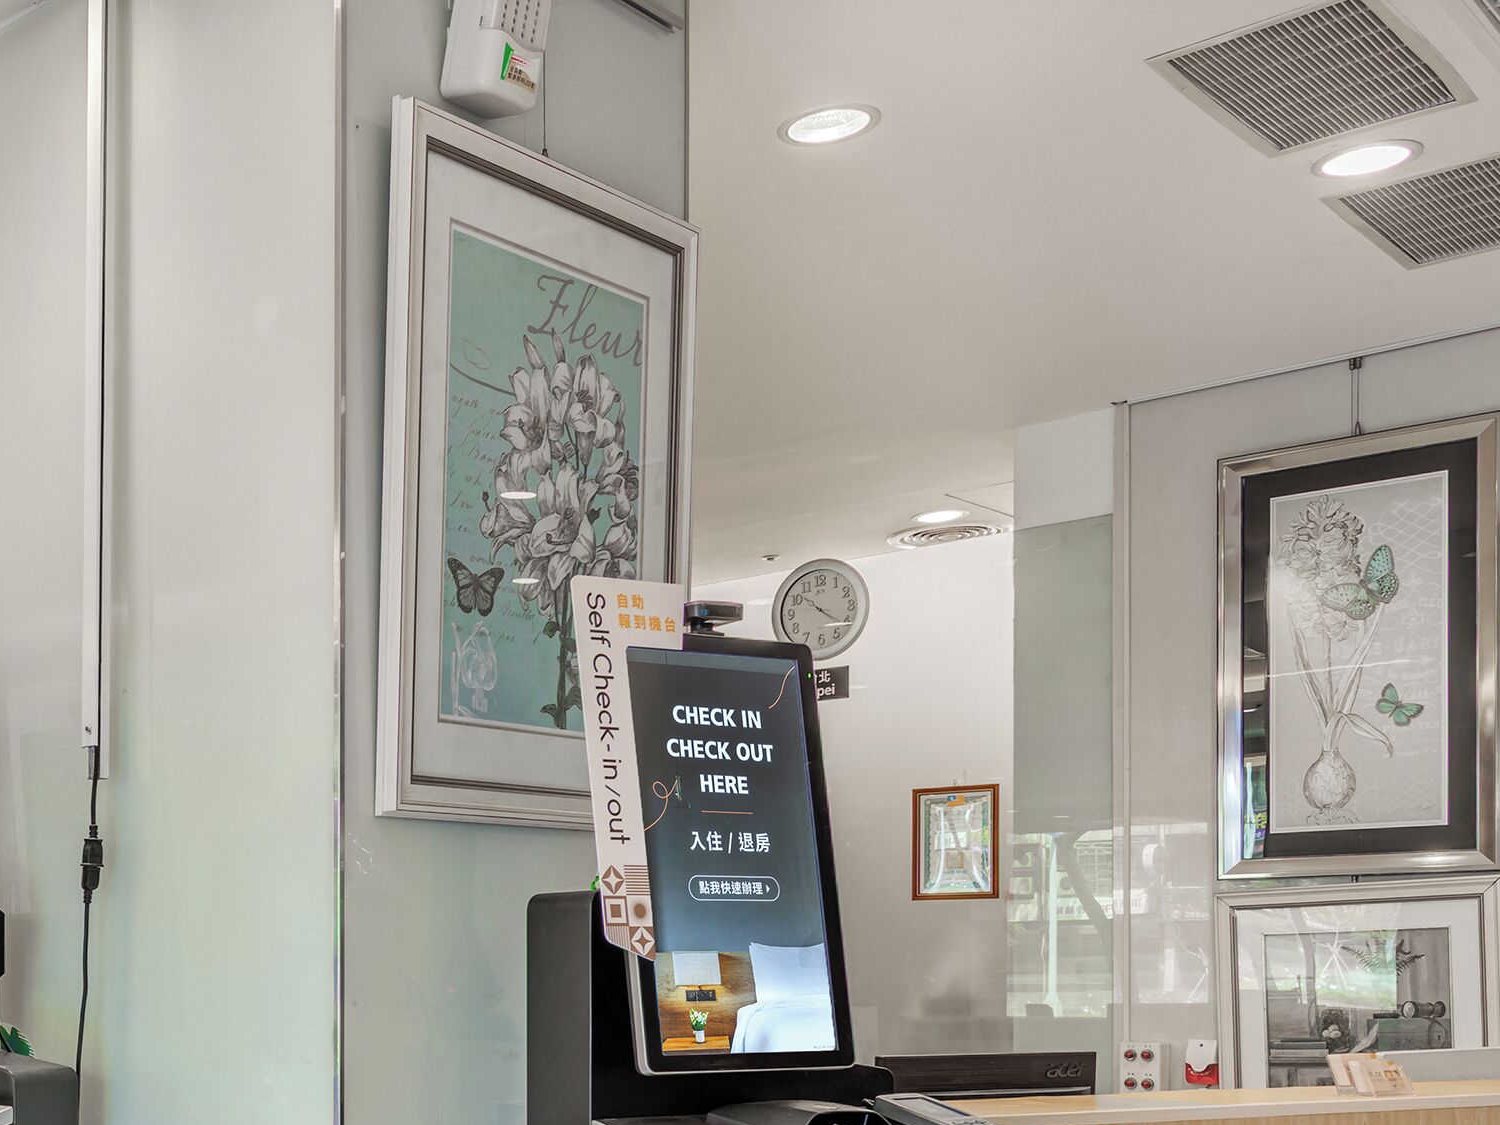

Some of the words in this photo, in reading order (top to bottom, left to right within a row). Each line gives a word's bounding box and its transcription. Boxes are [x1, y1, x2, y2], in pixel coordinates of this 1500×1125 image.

[527, 274, 643, 367] Fleur
[801, 581, 812, 593] 11
[814, 574, 826, 587] 12
[833, 576, 839, 588] 1
[842, 586, 851, 599] 2
[790, 593, 803, 606] 10
[847, 599, 855, 611] 3
[587, 592, 611, 648] Self
[787, 608, 795, 621] 9
[792, 622, 800, 634] 8
[833, 627, 840, 640] 5
[803, 632, 810, 643] 7
[819, 633, 826, 646] 6
[672, 705, 737, 728] CHECK
[742, 710, 762, 729] IN
[666, 738, 731, 760] CHECK
[736, 742, 773, 763] OUT
[700, 773, 749, 795] HERE
[690, 831, 723, 851] 入住
[738, 832, 770, 853] 退房
[698, 880, 763, 895] 點我快速辦理
[1046, 1063, 1087, 1078] acer
